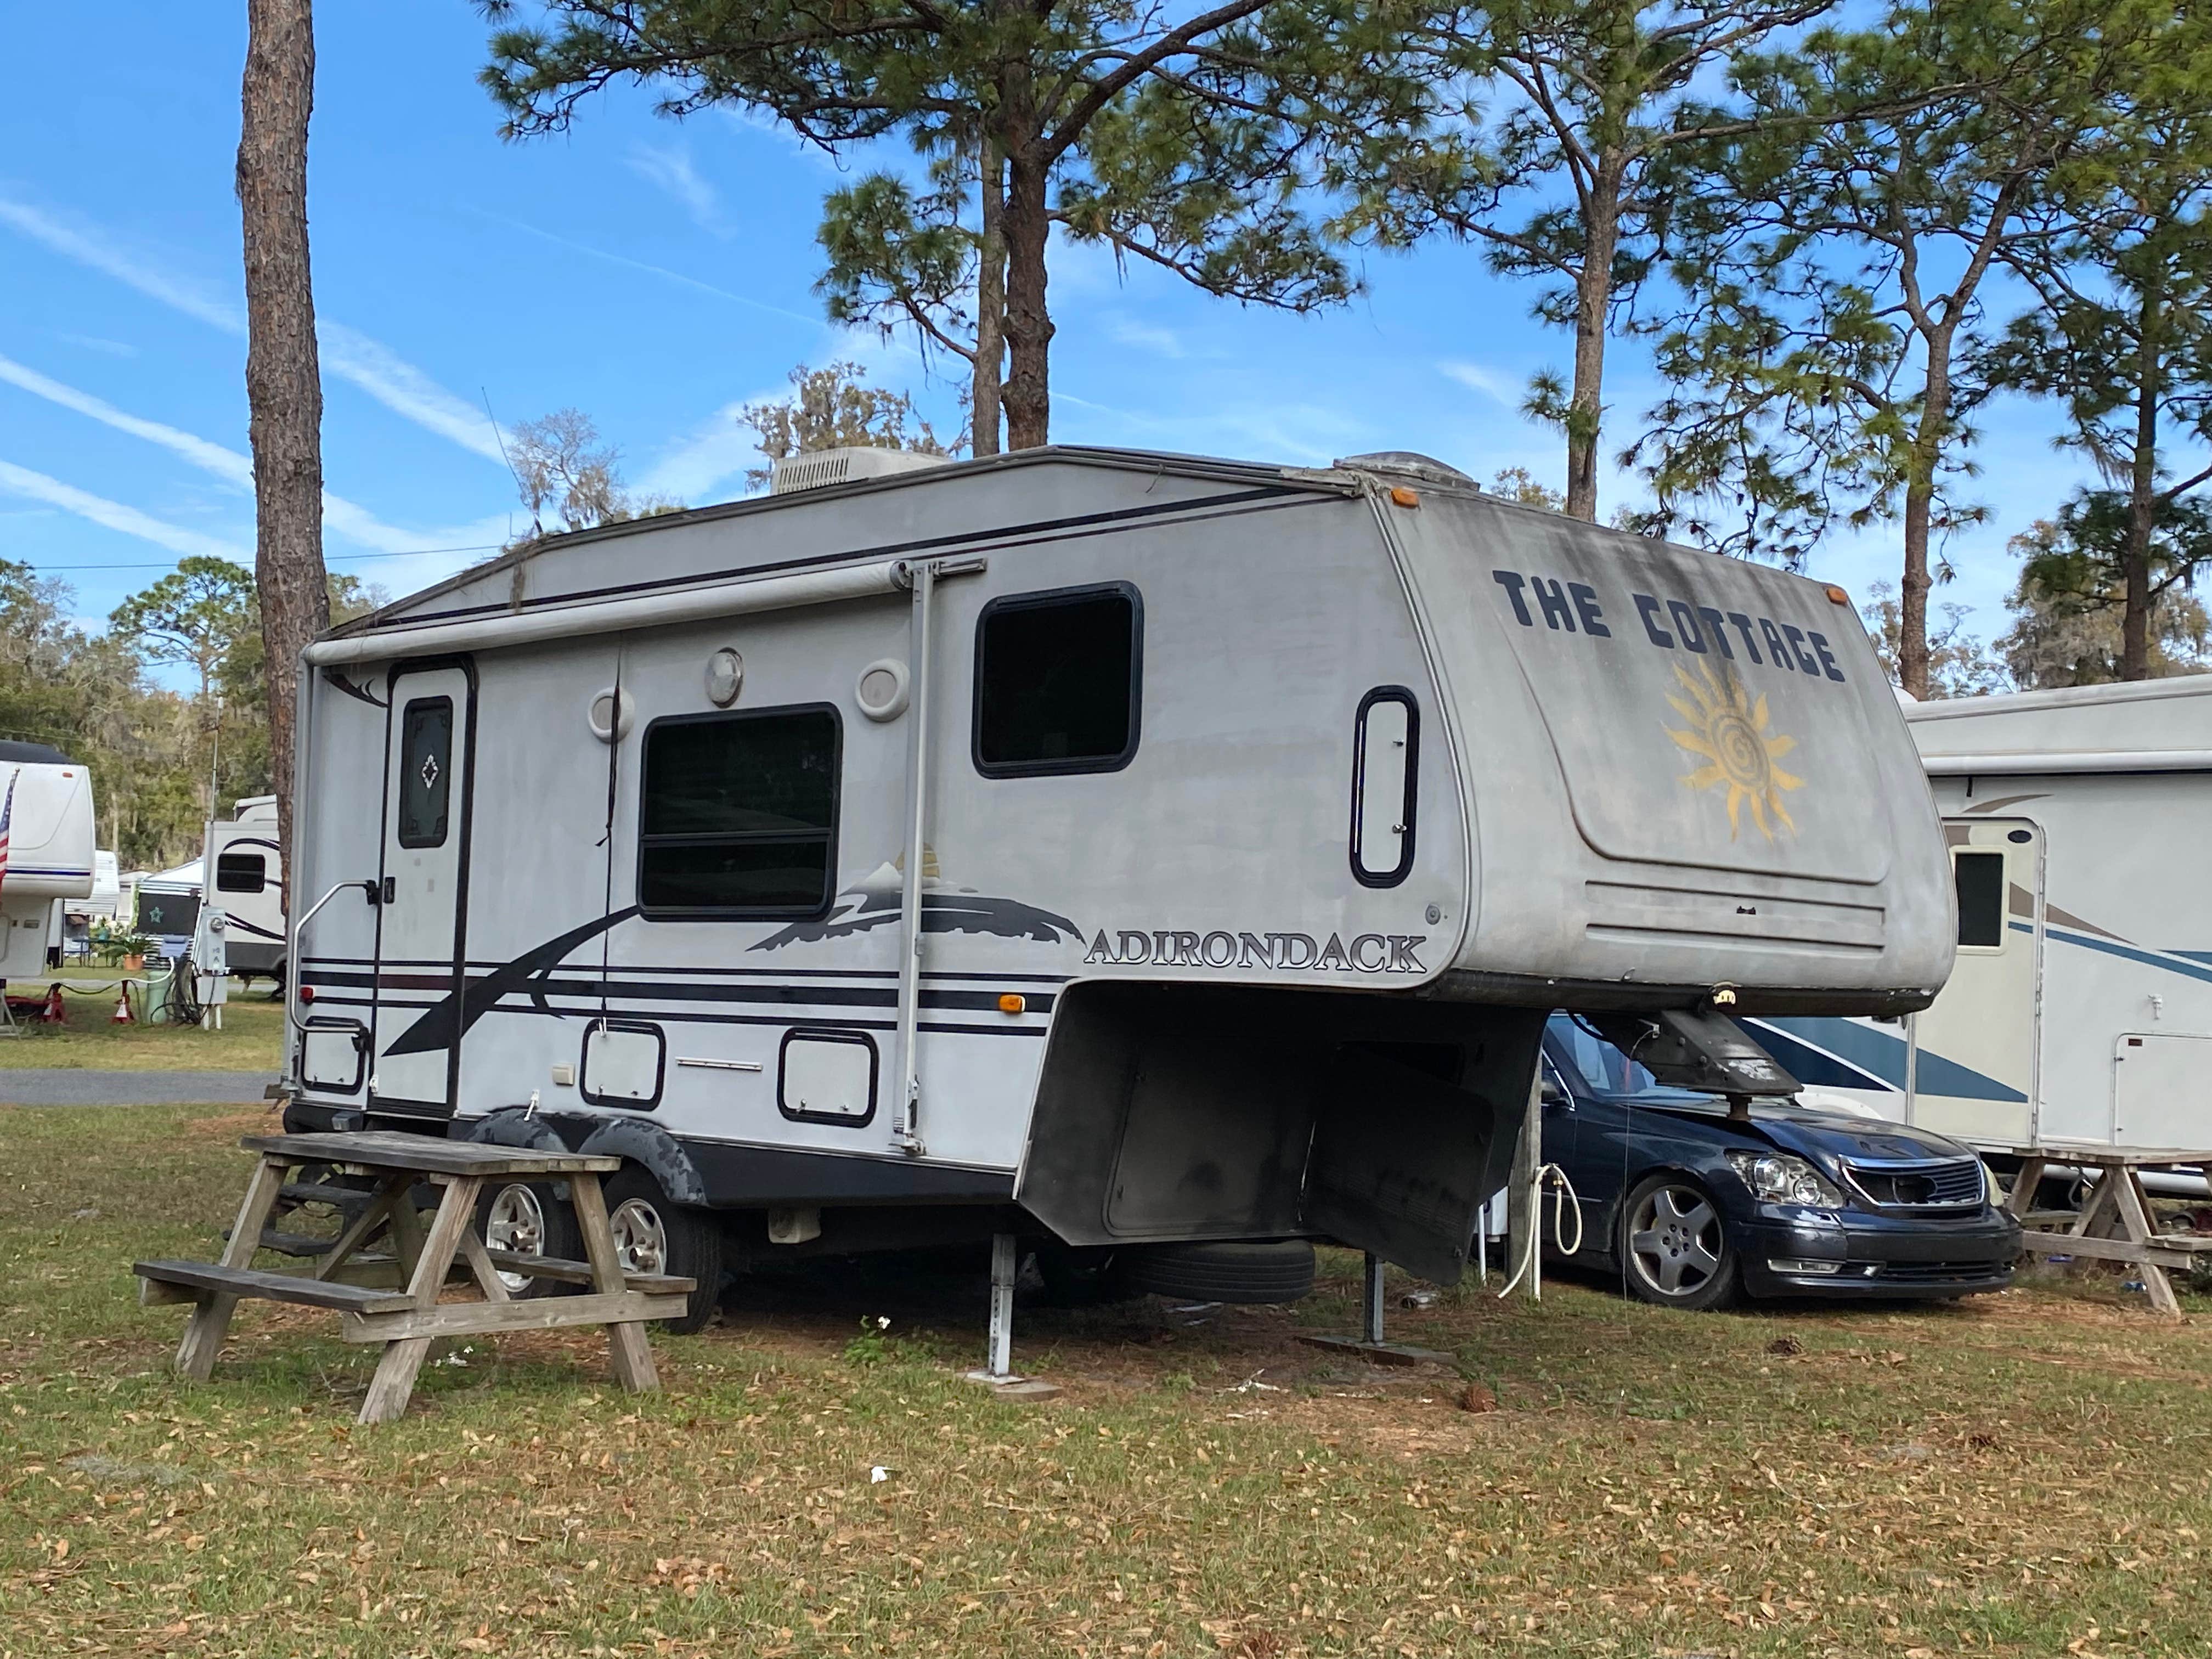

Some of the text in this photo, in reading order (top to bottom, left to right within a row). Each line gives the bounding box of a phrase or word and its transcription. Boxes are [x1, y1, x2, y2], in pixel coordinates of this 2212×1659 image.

[1493, 570, 1846, 682] THE COTTAGE
[1084, 929, 1427, 973] ADIRONDACK
